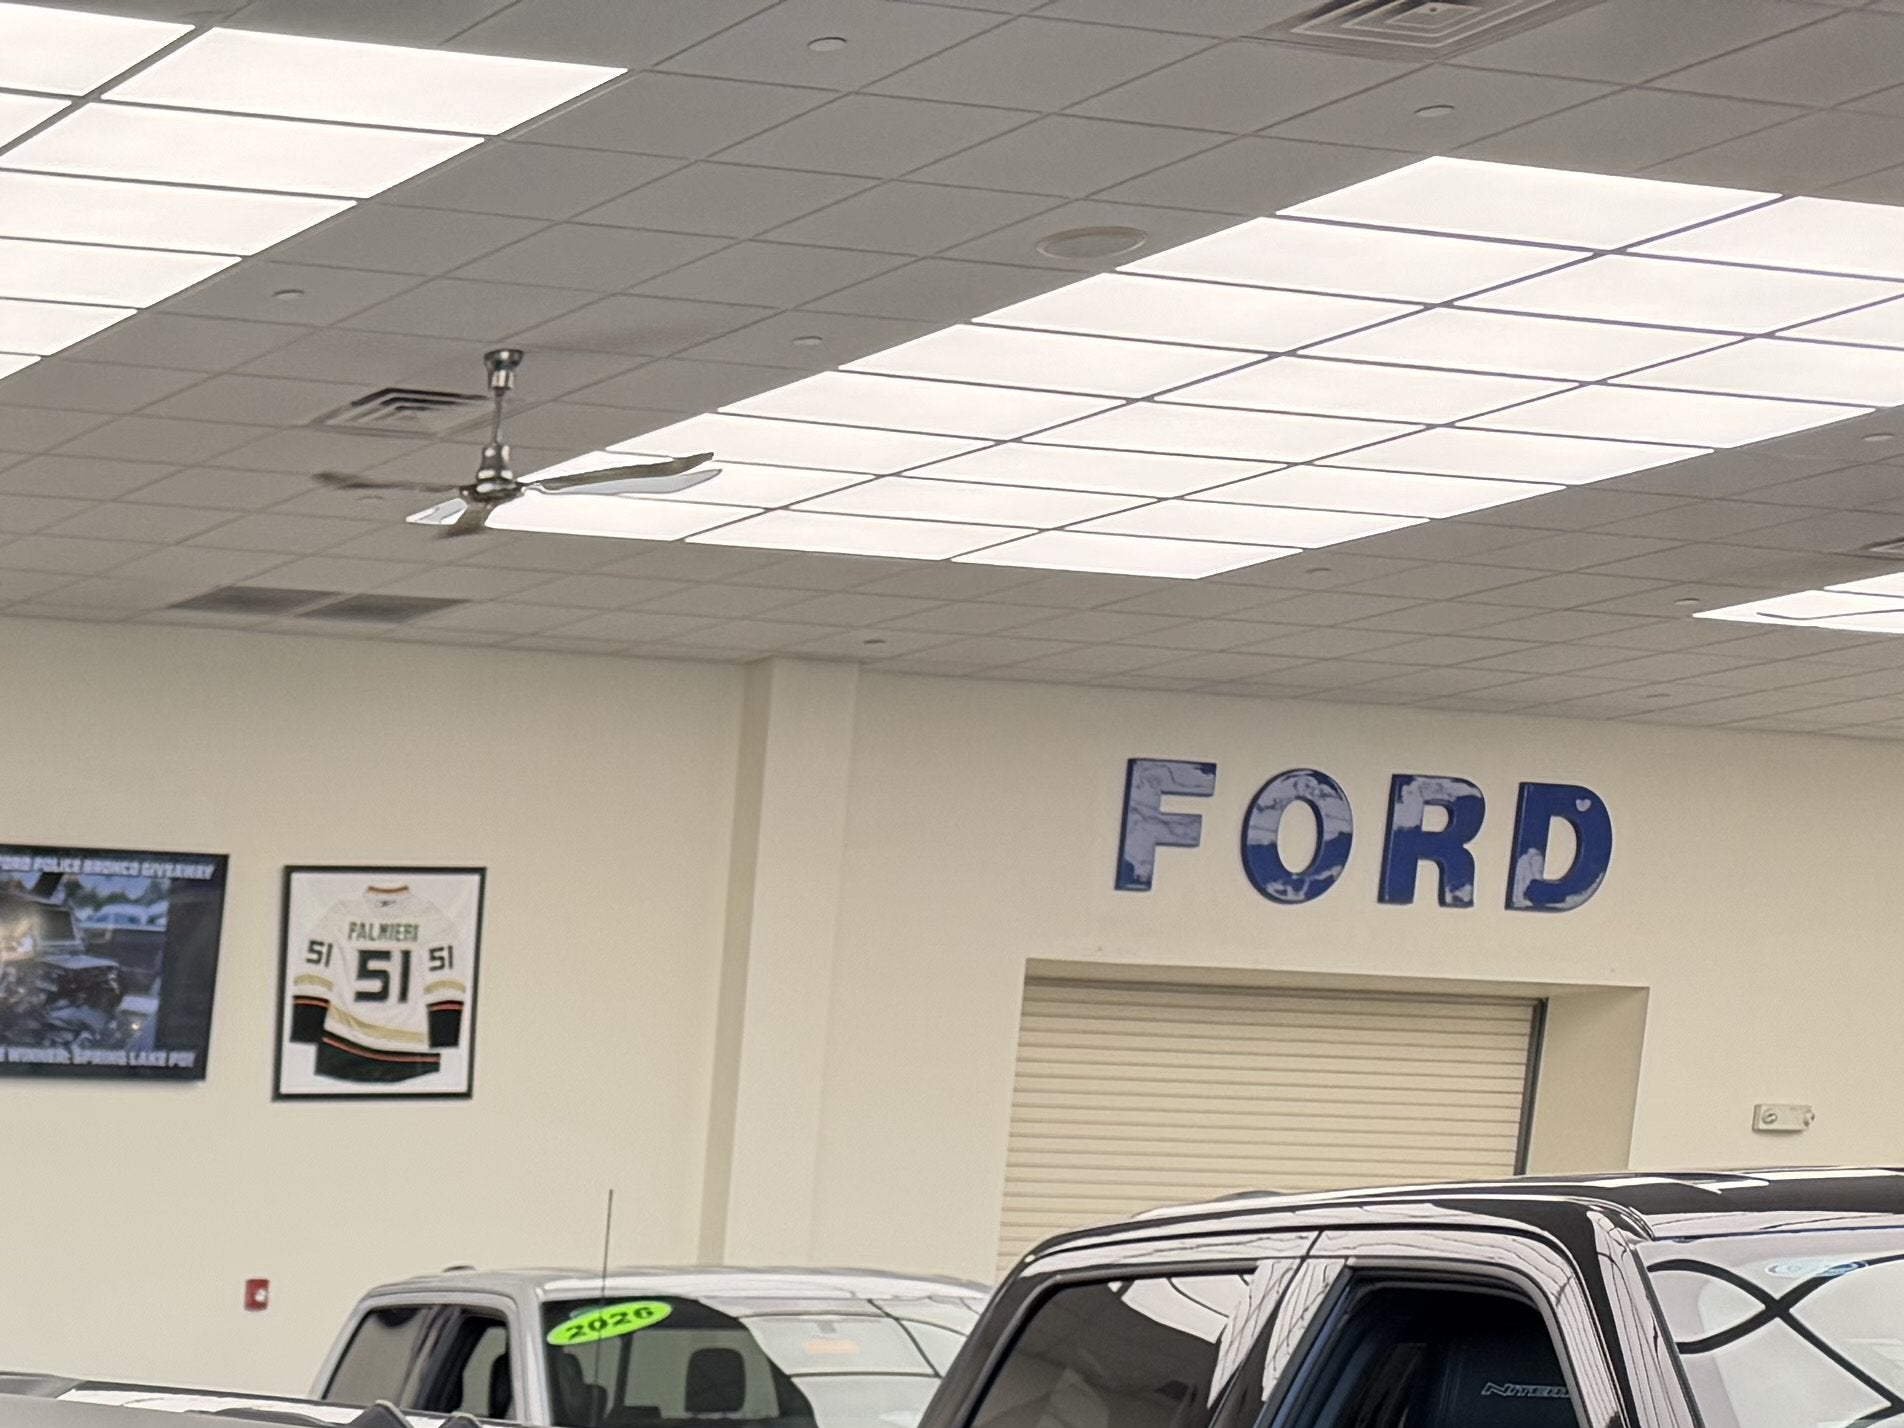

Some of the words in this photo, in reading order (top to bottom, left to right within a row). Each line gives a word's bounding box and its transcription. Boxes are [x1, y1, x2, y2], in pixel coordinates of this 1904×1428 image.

[1114, 757, 1613, 912] FORD
[348, 921, 419, 942] PALMIERI
[306, 940, 333, 968] 51
[429, 945, 453, 971] 51
[354, 950, 411, 1003] 51
[565, 1307, 654, 1341] 2026
